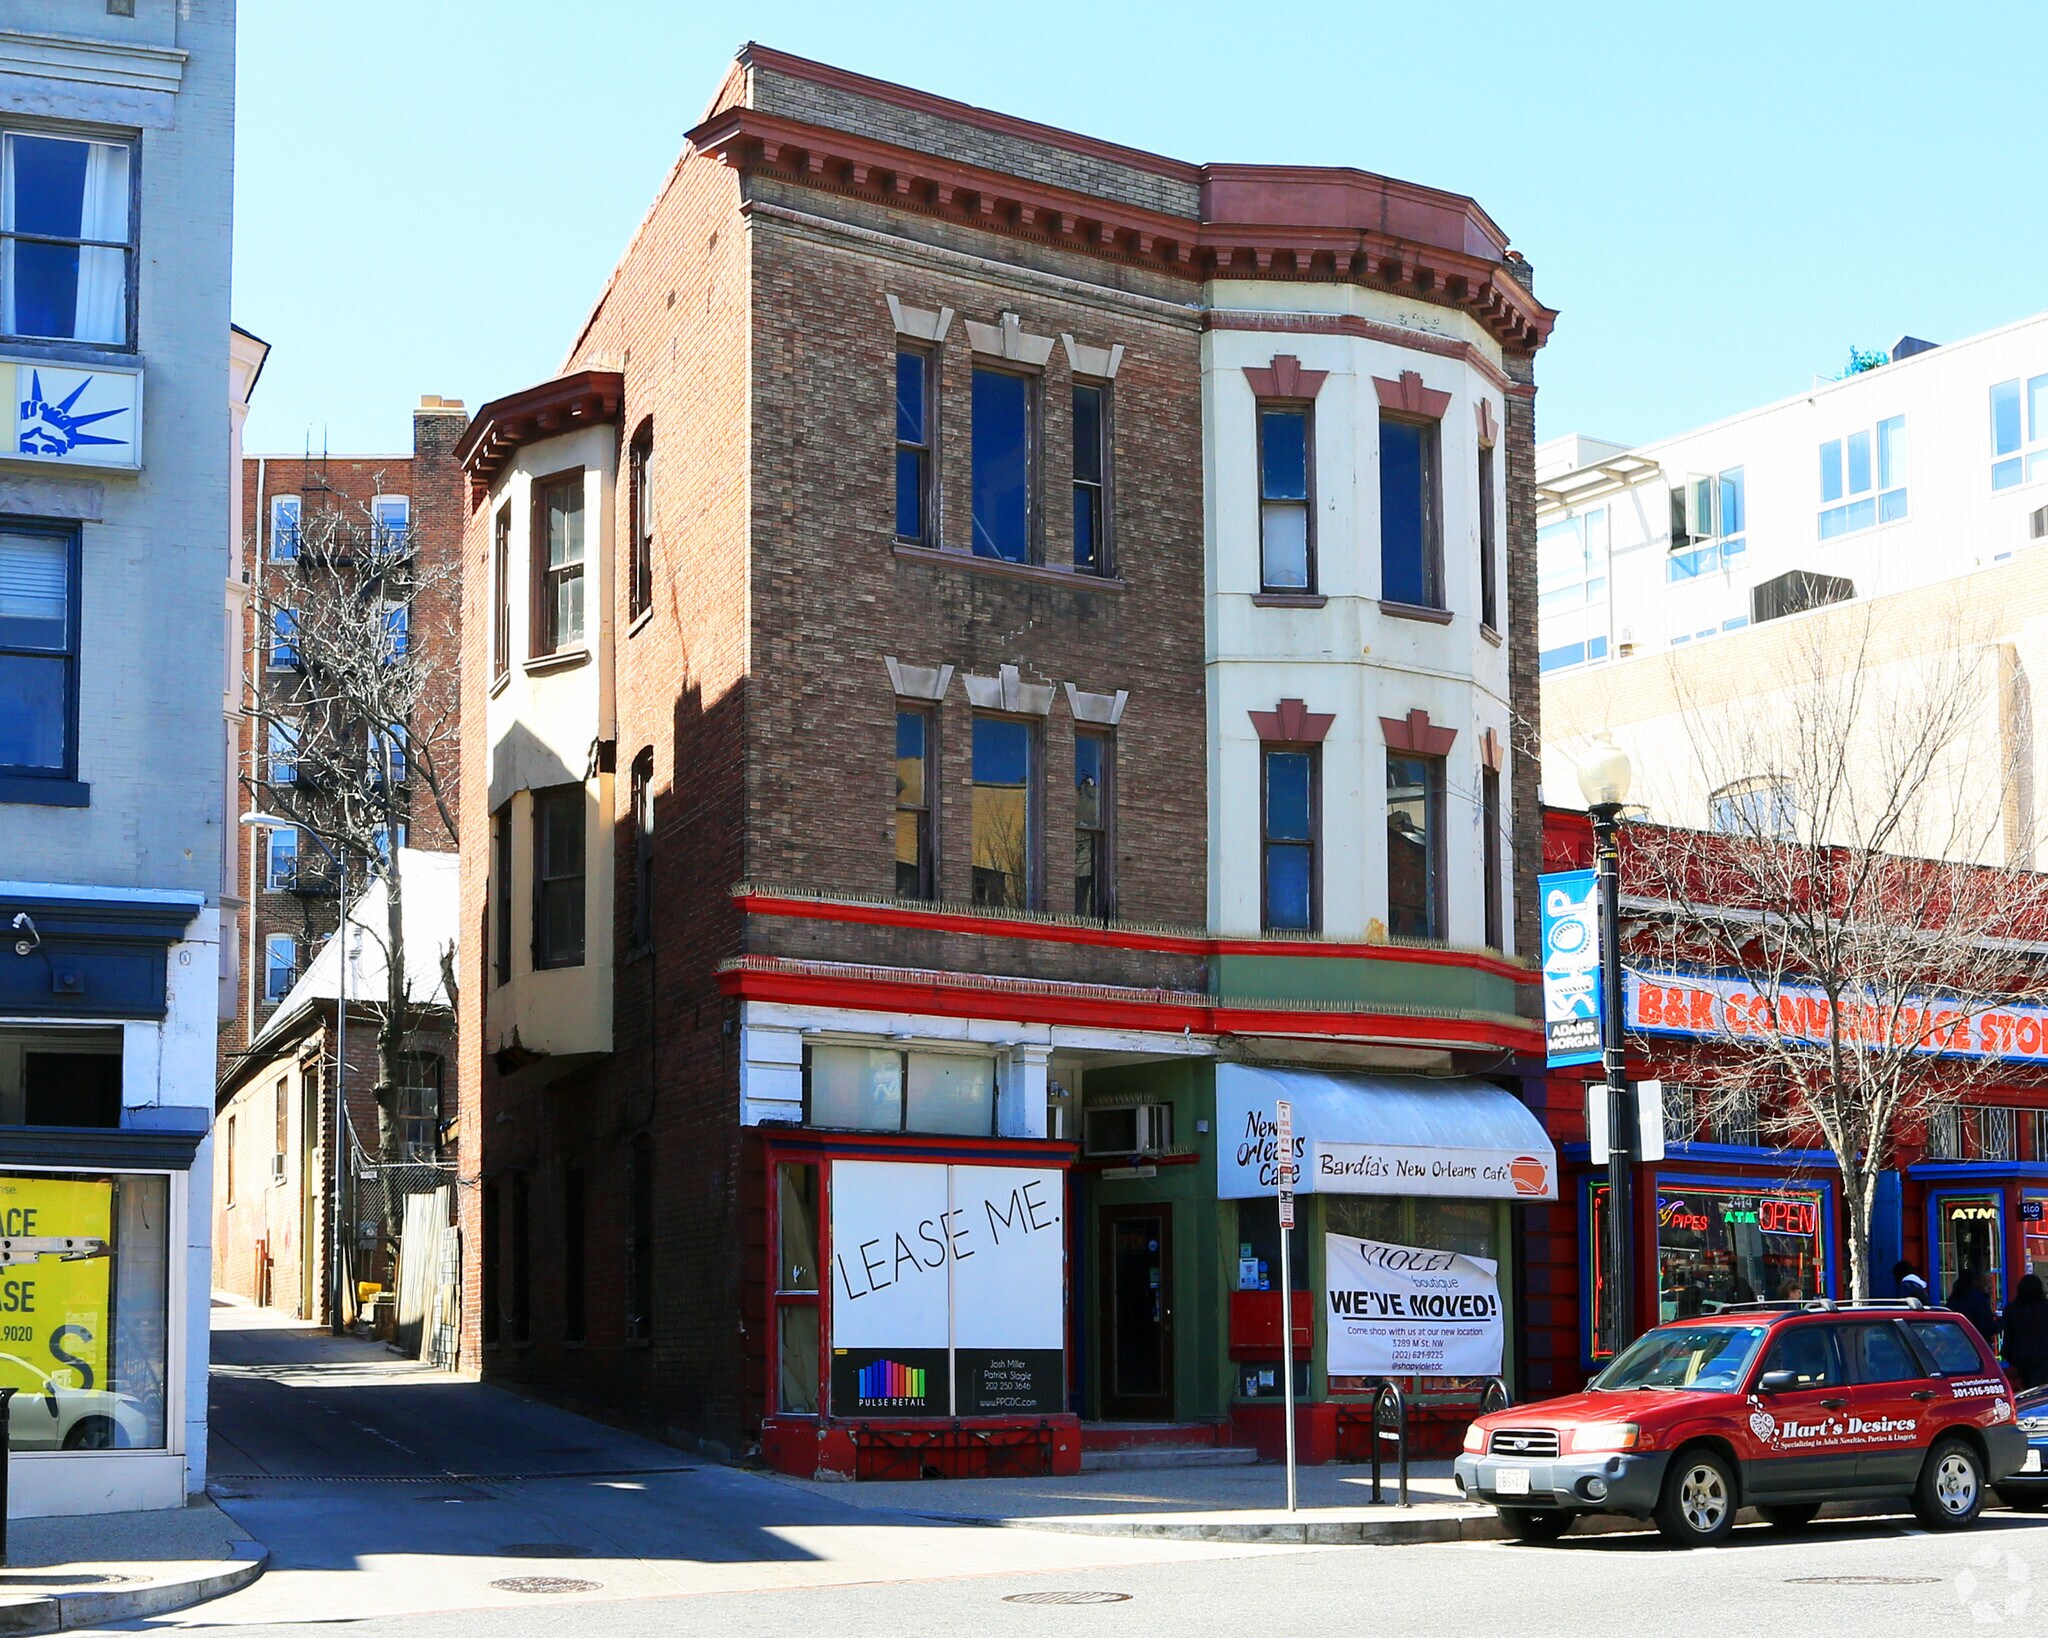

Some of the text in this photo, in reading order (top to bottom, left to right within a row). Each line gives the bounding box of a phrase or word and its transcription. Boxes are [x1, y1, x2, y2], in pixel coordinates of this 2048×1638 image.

[1547, 889, 1597, 1017] SHOP
[1638, 983, 1715, 1029] B&K
[1552, 1021, 1595, 1038] ADAMS
[1549, 1034, 1600, 1051] MORGAN
[1237, 1137, 1306, 1166] Orleas
[1260, 1163, 1301, 1186] Cae
[1319, 1153, 1508, 1181] Bardia's New Orleans Cafe
[1672, 1214, 1708, 1230] PIPES
[1724, 1211, 1756, 1223] ATM
[1761, 1202, 1814, 1233] OPEN
[838, 1180, 1060, 1300] LEASE ME.
[1411, 1275, 1459, 1292] boutique
[0, 1281, 35, 1312] SE
[1329, 1291, 1497, 1317] WE'VE MOVED!
[1347, 1326, 1368, 1336] Come
[1370, 1327, 1386, 1337] shop
[1389, 1327, 1405, 1336] with
[1408, 1328, 1416, 1336] us
[1418, 1328, 1425, 1336] at
[1441, 1329, 1455, 1337] new
[1457, 1328, 1484, 1337] location.
[1412, 1339, 1420, 1347] M
[1421, 1339, 1431, 1348] St.
[1432, 1339, 1444, 1347] NW
[990, 1359, 1026, 1368] Josh Miller
[1392, 1350, 1411, 1360] (202)
[984, 1369, 1007, 1379] Patrick
[1391, 1362, 1443, 1371] @shopvioletdc
[985, 1381, 998, 1390] 202
[1000, 1381, 1013, 1390] 250
[858, 1398, 925, 1407] PULSE RETAIL
[1782, 1416, 1916, 1439] Hart's Desires
[1780, 1440, 1815, 1449] Specializing
[1823, 1437, 1838, 1445] Adult
[1868, 1435, 1887, 1443] Parties
[1894, 1433, 1917, 1442] Lingerie
